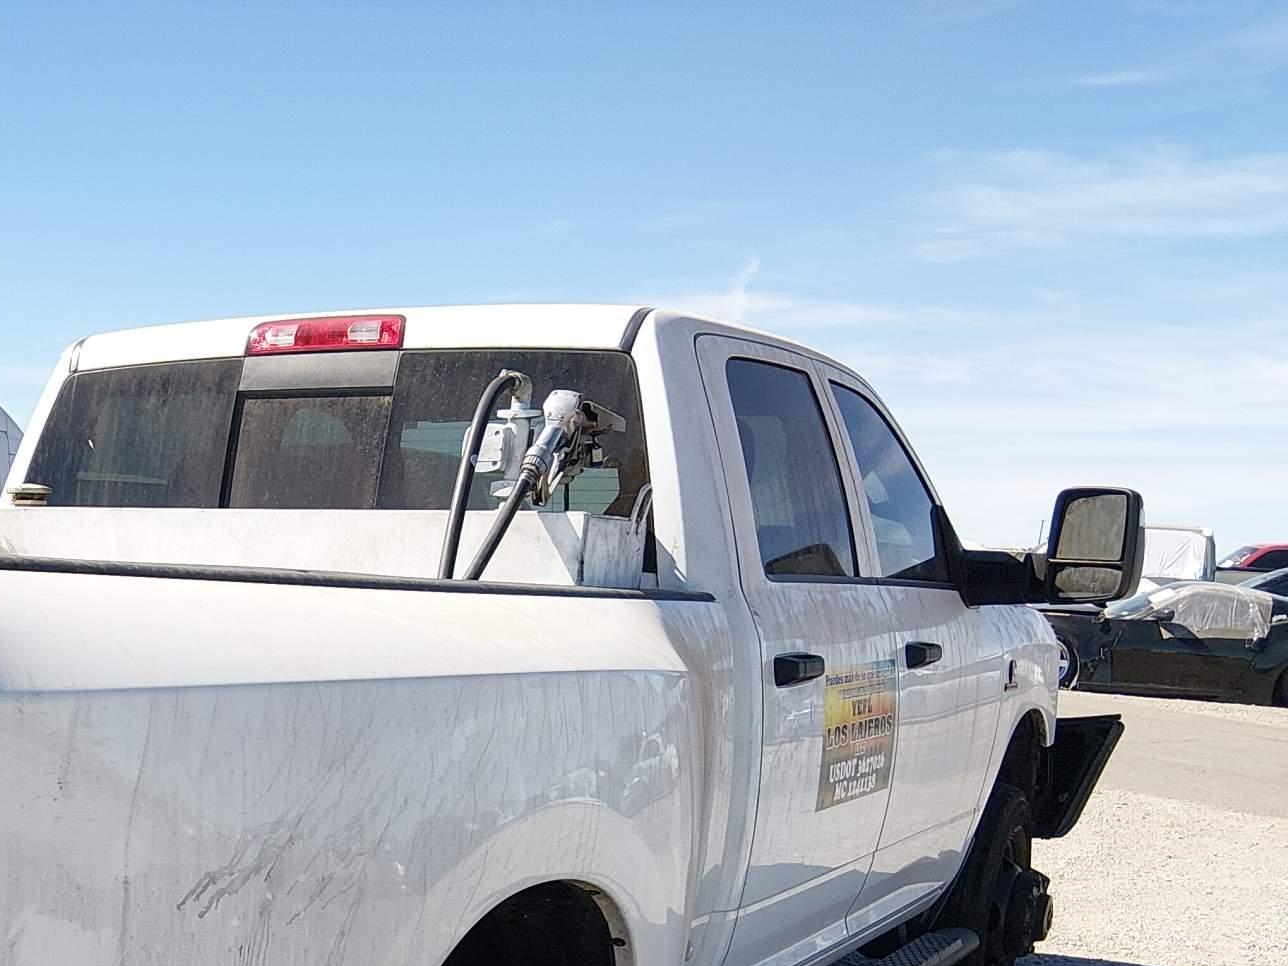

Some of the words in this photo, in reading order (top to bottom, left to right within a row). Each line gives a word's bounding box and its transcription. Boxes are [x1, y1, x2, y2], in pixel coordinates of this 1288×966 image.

[826, 724, 848, 749] LOS
[850, 714, 893, 742] LAJEROS
[829, 758, 858, 784] USDOT
[833, 780, 847, 801] MC
